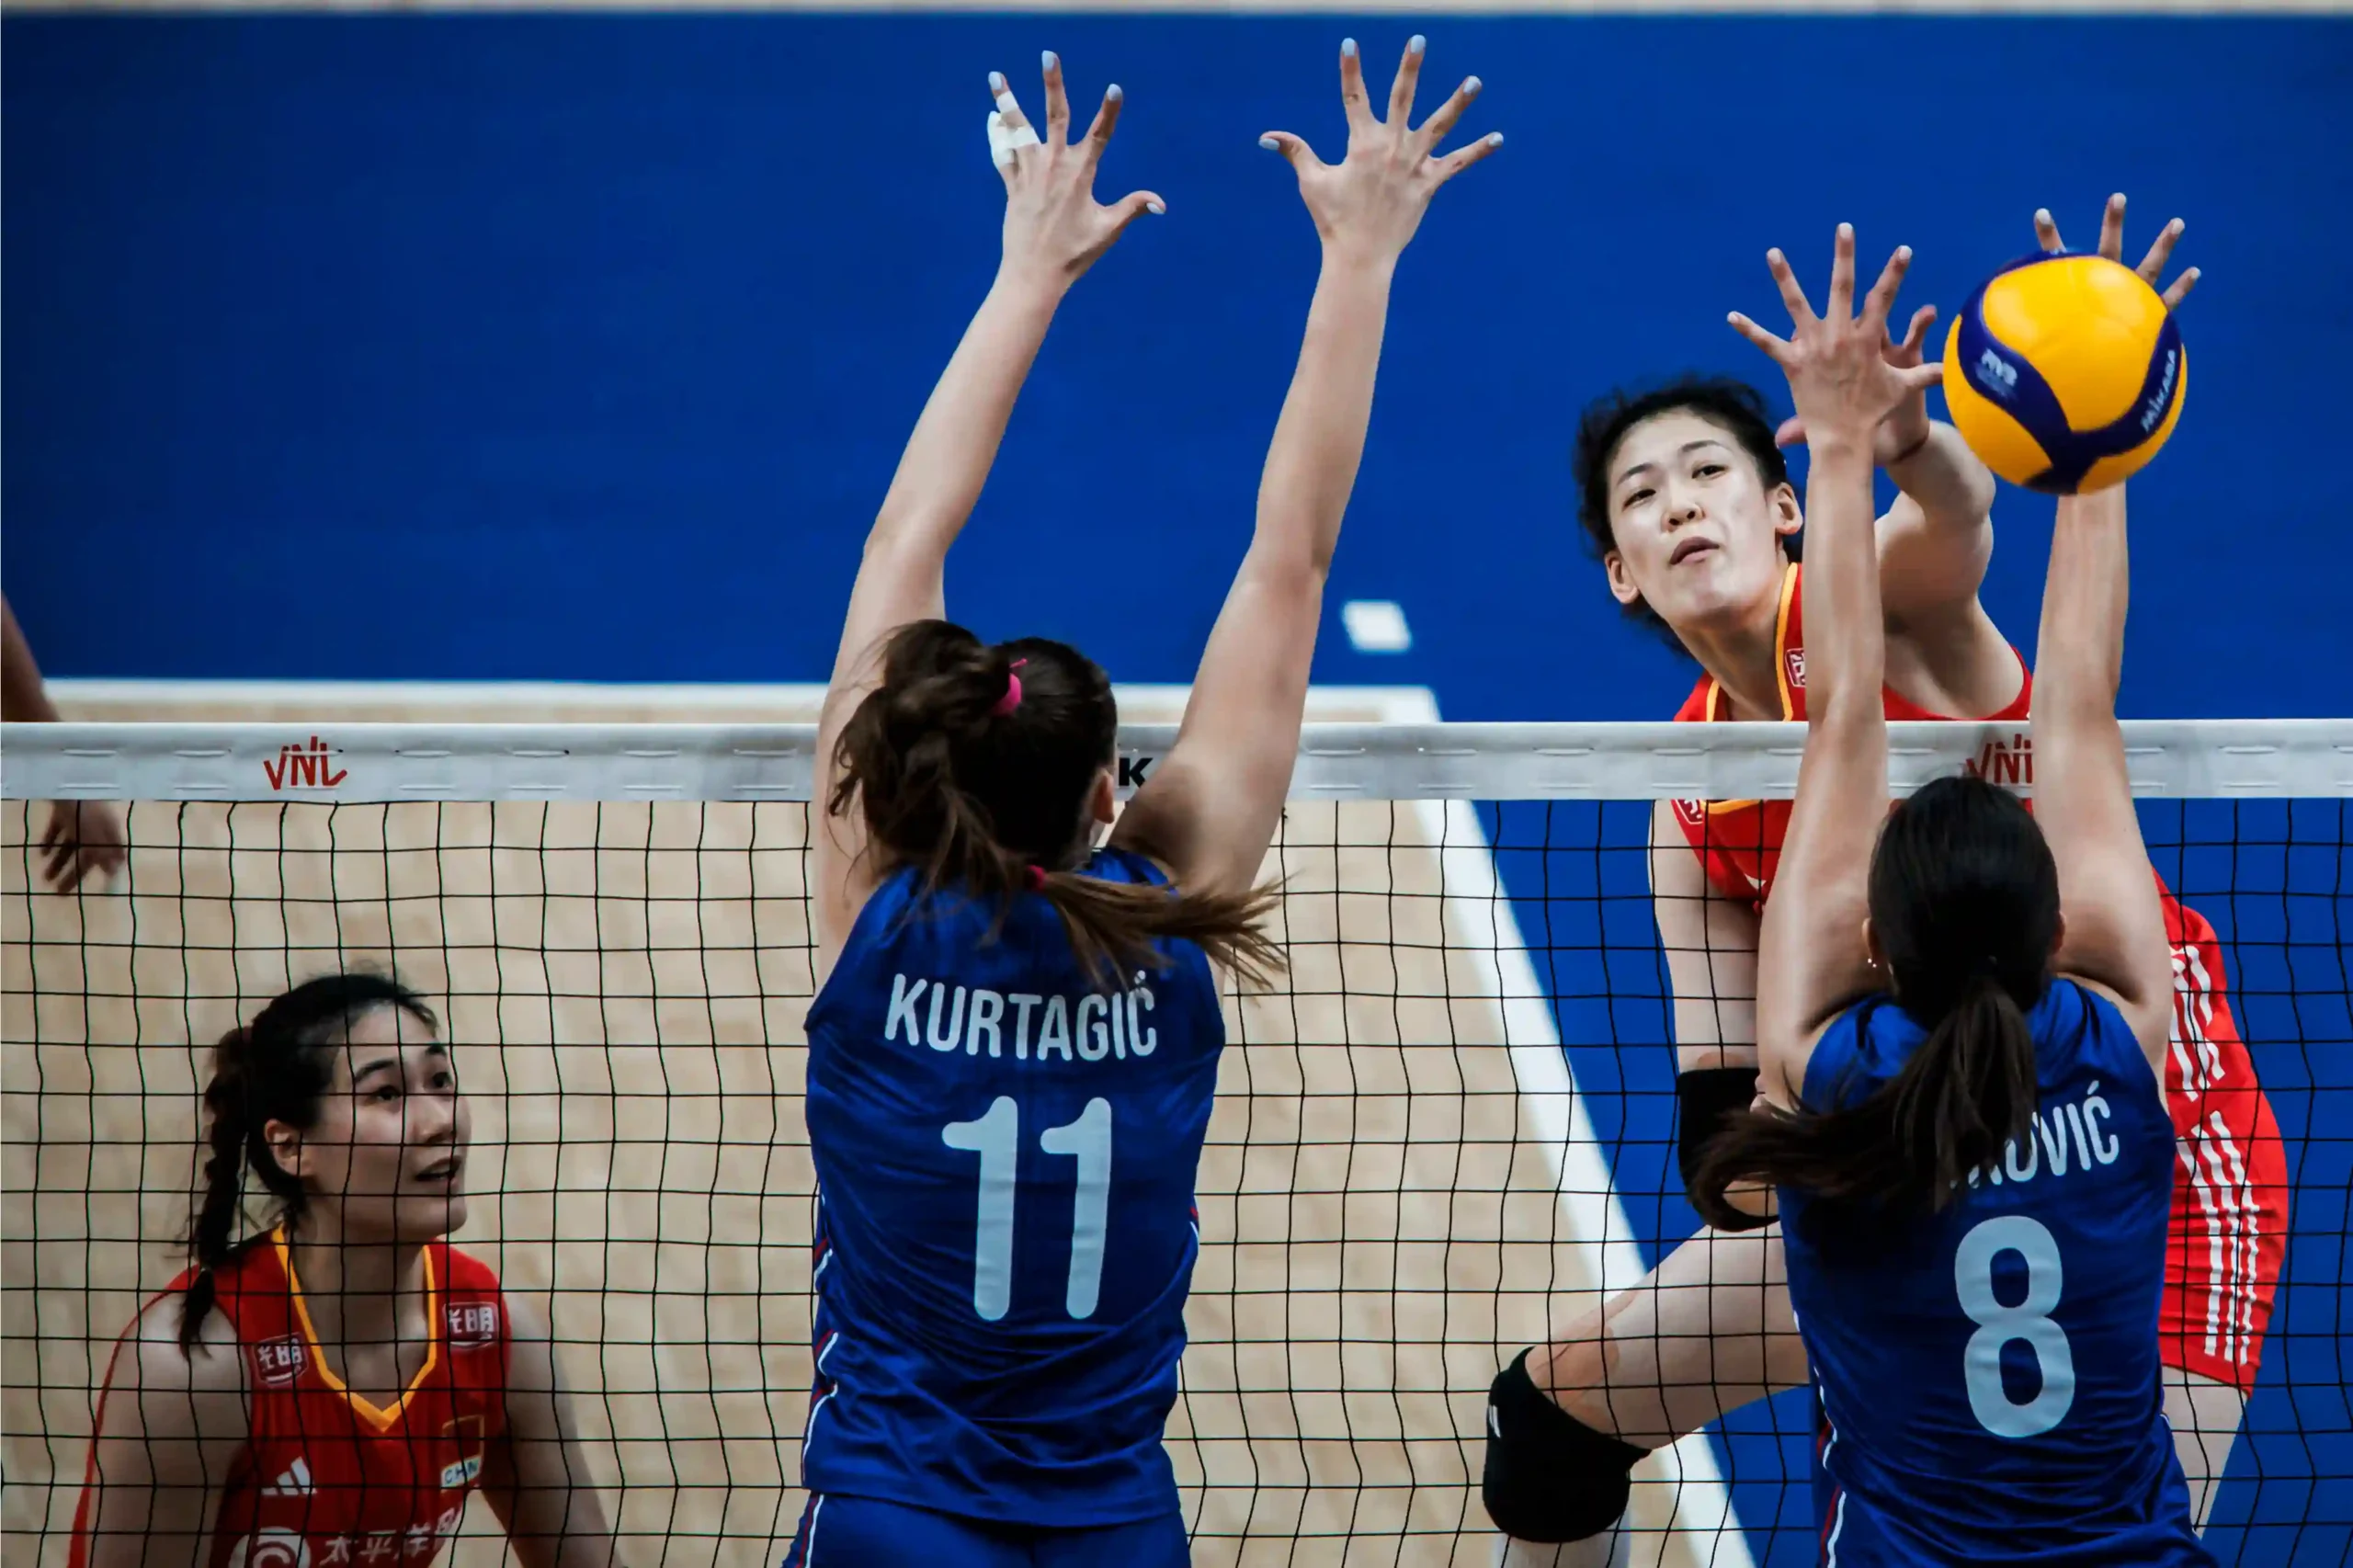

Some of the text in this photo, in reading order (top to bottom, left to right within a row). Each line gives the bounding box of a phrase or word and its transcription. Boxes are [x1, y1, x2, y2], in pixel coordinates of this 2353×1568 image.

[263, 735, 347, 790] VNL
[884, 970, 1157, 1061] KURTAGIĆ
[1949, 1080, 2120, 1188] OVIĆ
[941, 1096, 1112, 1321] 11
[1954, 1215, 2075, 1437] 8
